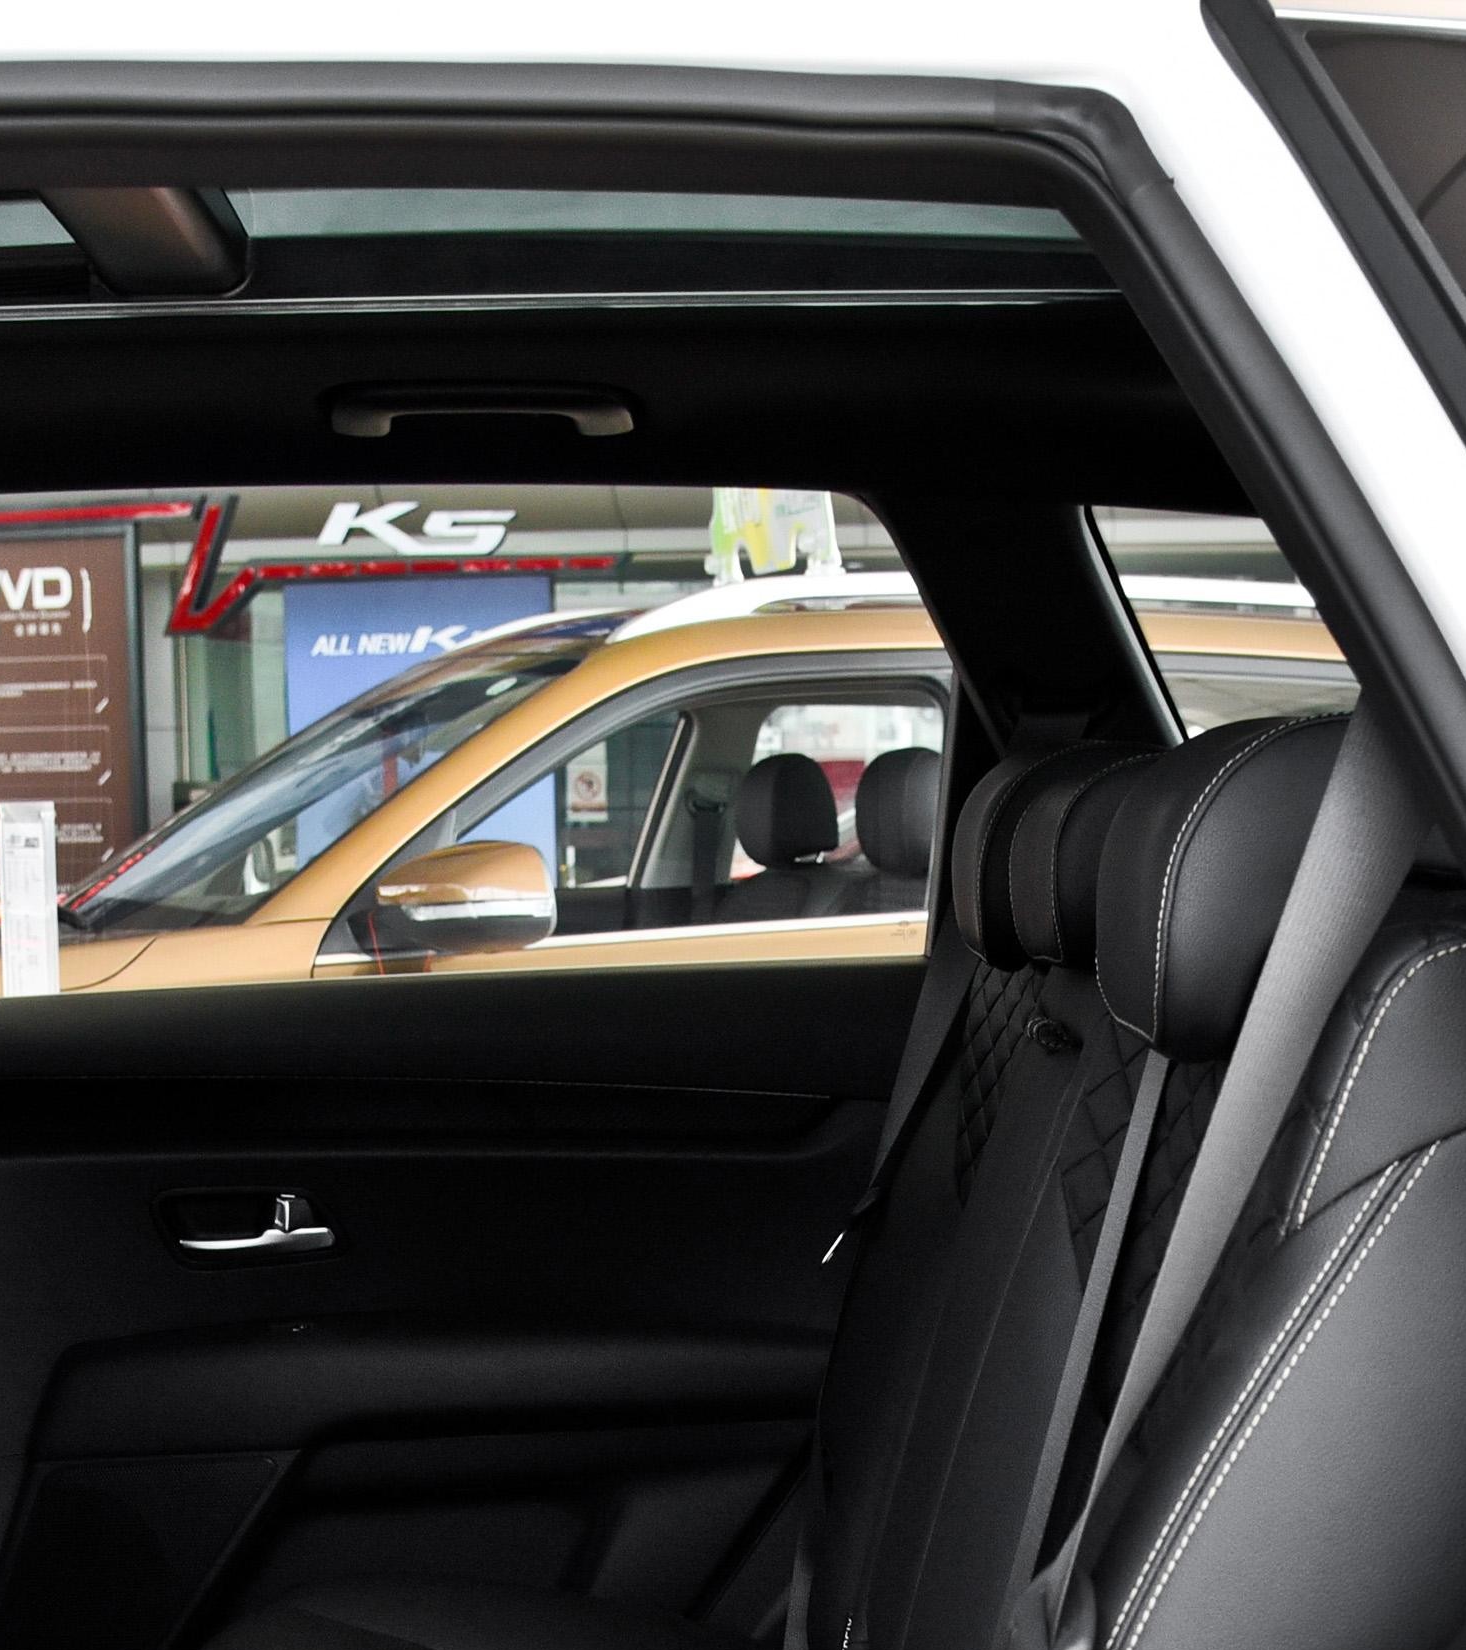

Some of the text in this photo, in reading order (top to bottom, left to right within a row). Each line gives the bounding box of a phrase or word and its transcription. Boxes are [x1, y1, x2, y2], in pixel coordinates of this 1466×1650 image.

[317, 501, 517, 556] K5
[311, 624, 485, 657] ALL NEW K
